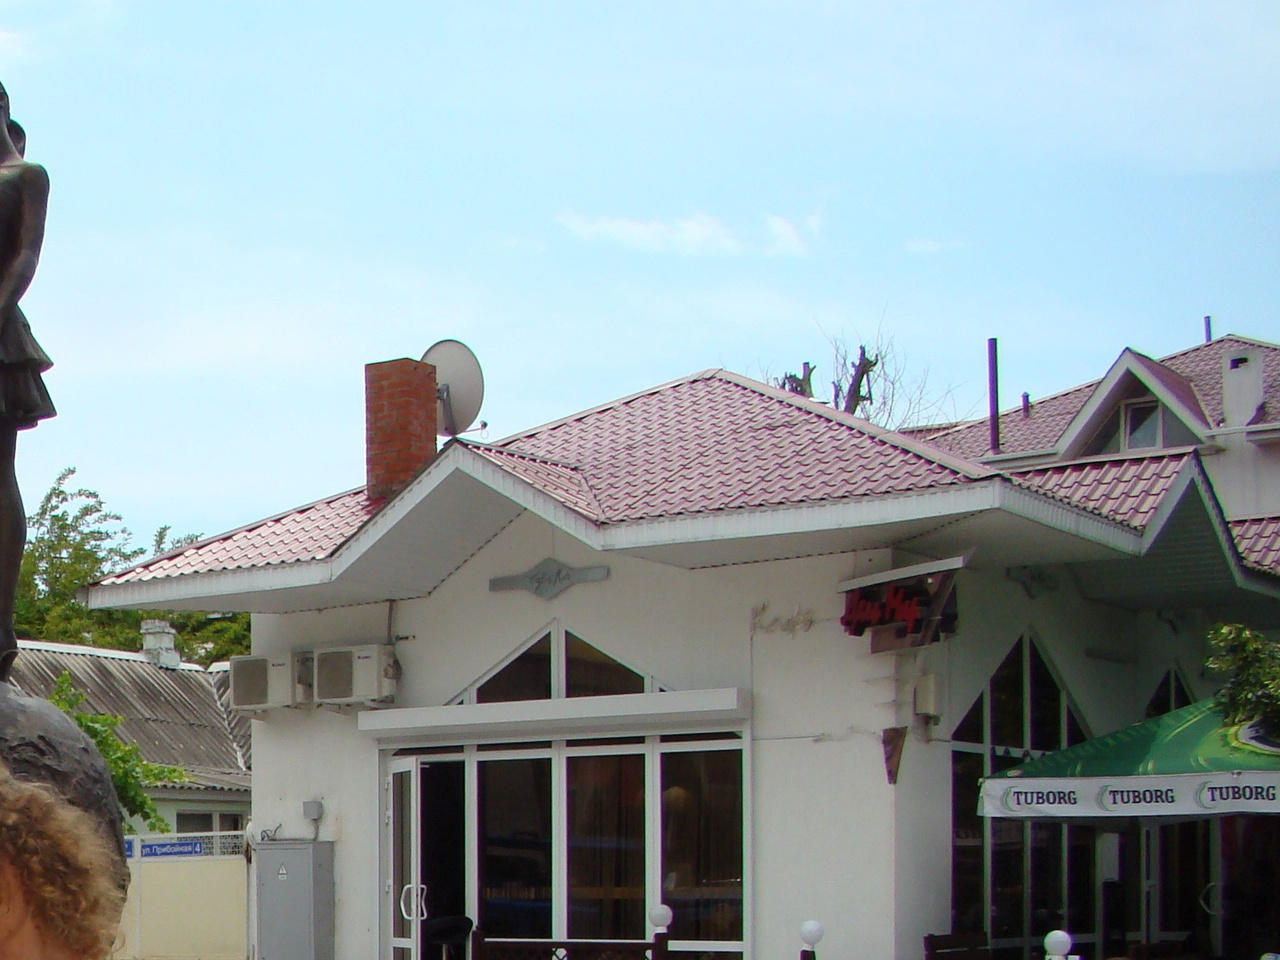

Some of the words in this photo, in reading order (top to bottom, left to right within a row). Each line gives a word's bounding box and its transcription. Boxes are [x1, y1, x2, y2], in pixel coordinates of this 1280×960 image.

[1013, 790, 1077, 806] TUBORG
[1109, 789, 1176, 805] TUBORG
[1208, 785, 1276, 802] TUBORG
[195, 842, 201, 853] 4
